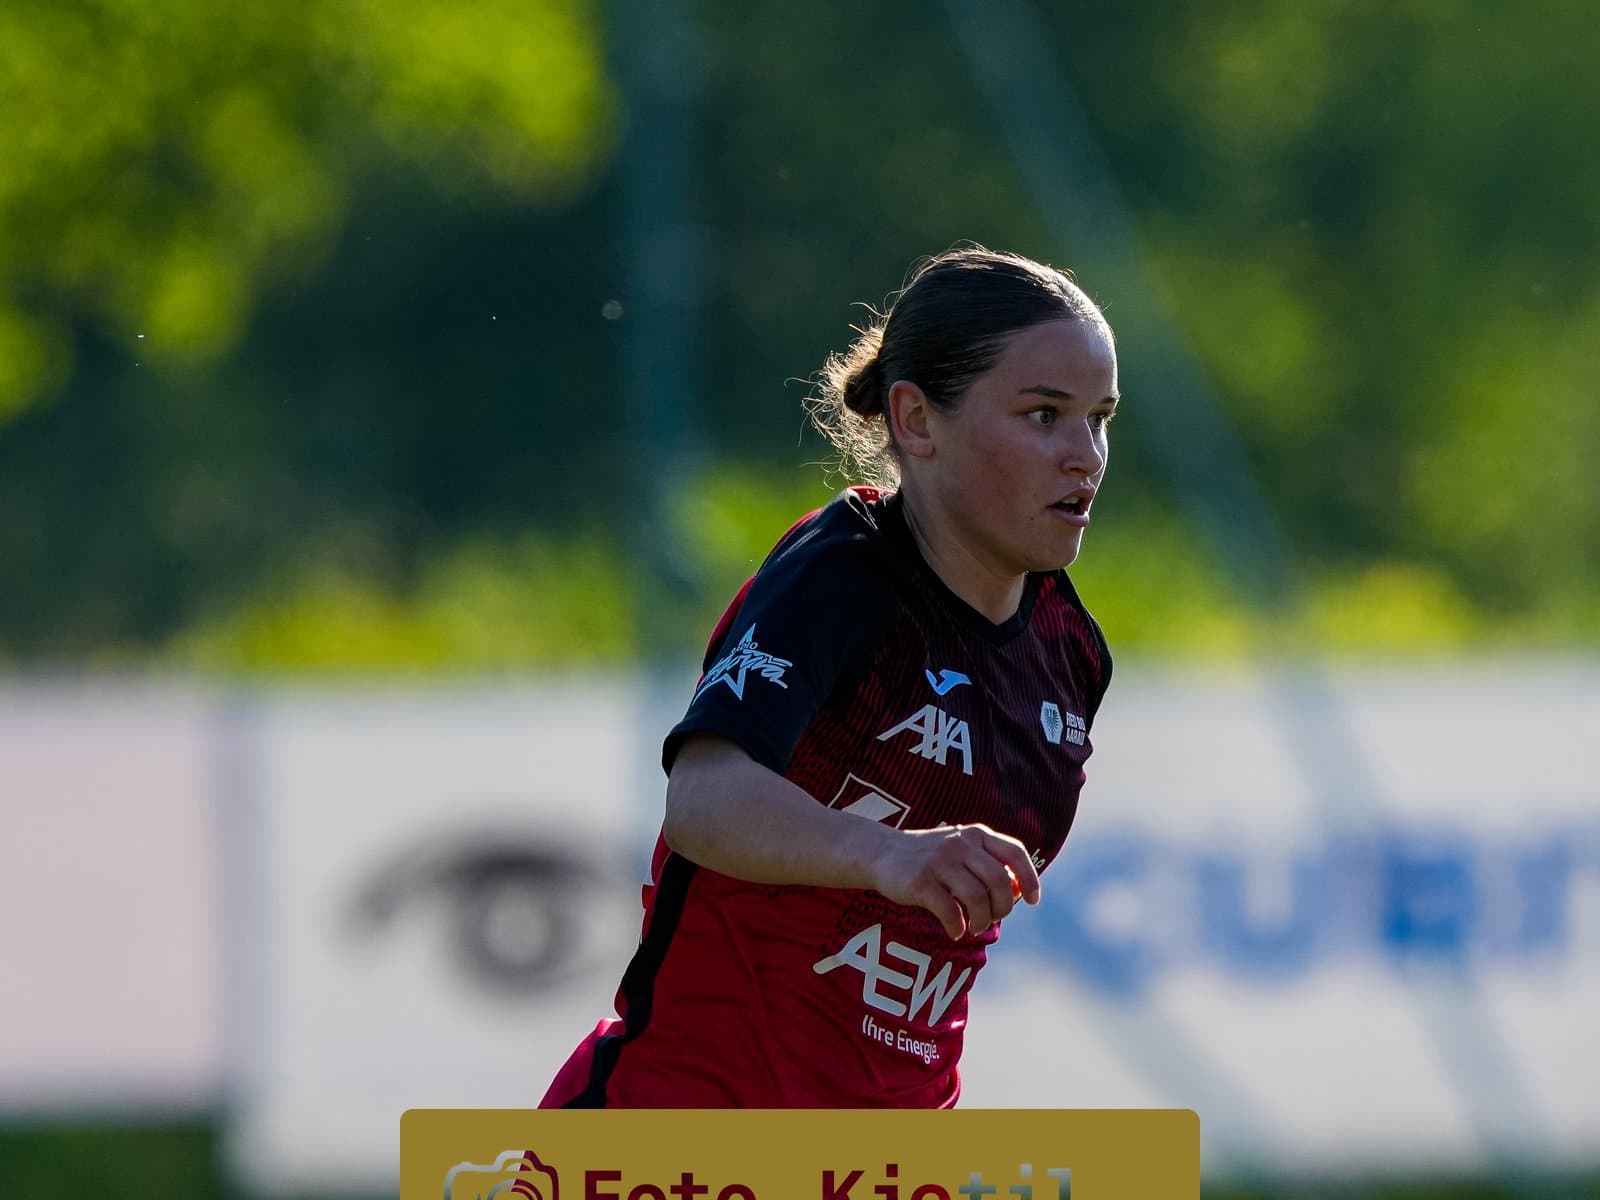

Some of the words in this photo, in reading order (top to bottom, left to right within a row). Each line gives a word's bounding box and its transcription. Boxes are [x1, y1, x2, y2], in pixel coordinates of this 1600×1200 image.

[876, 703, 973, 776] AXA
[813, 923, 972, 1027] AEW
[862, 1014, 893, 1047] Ihre
